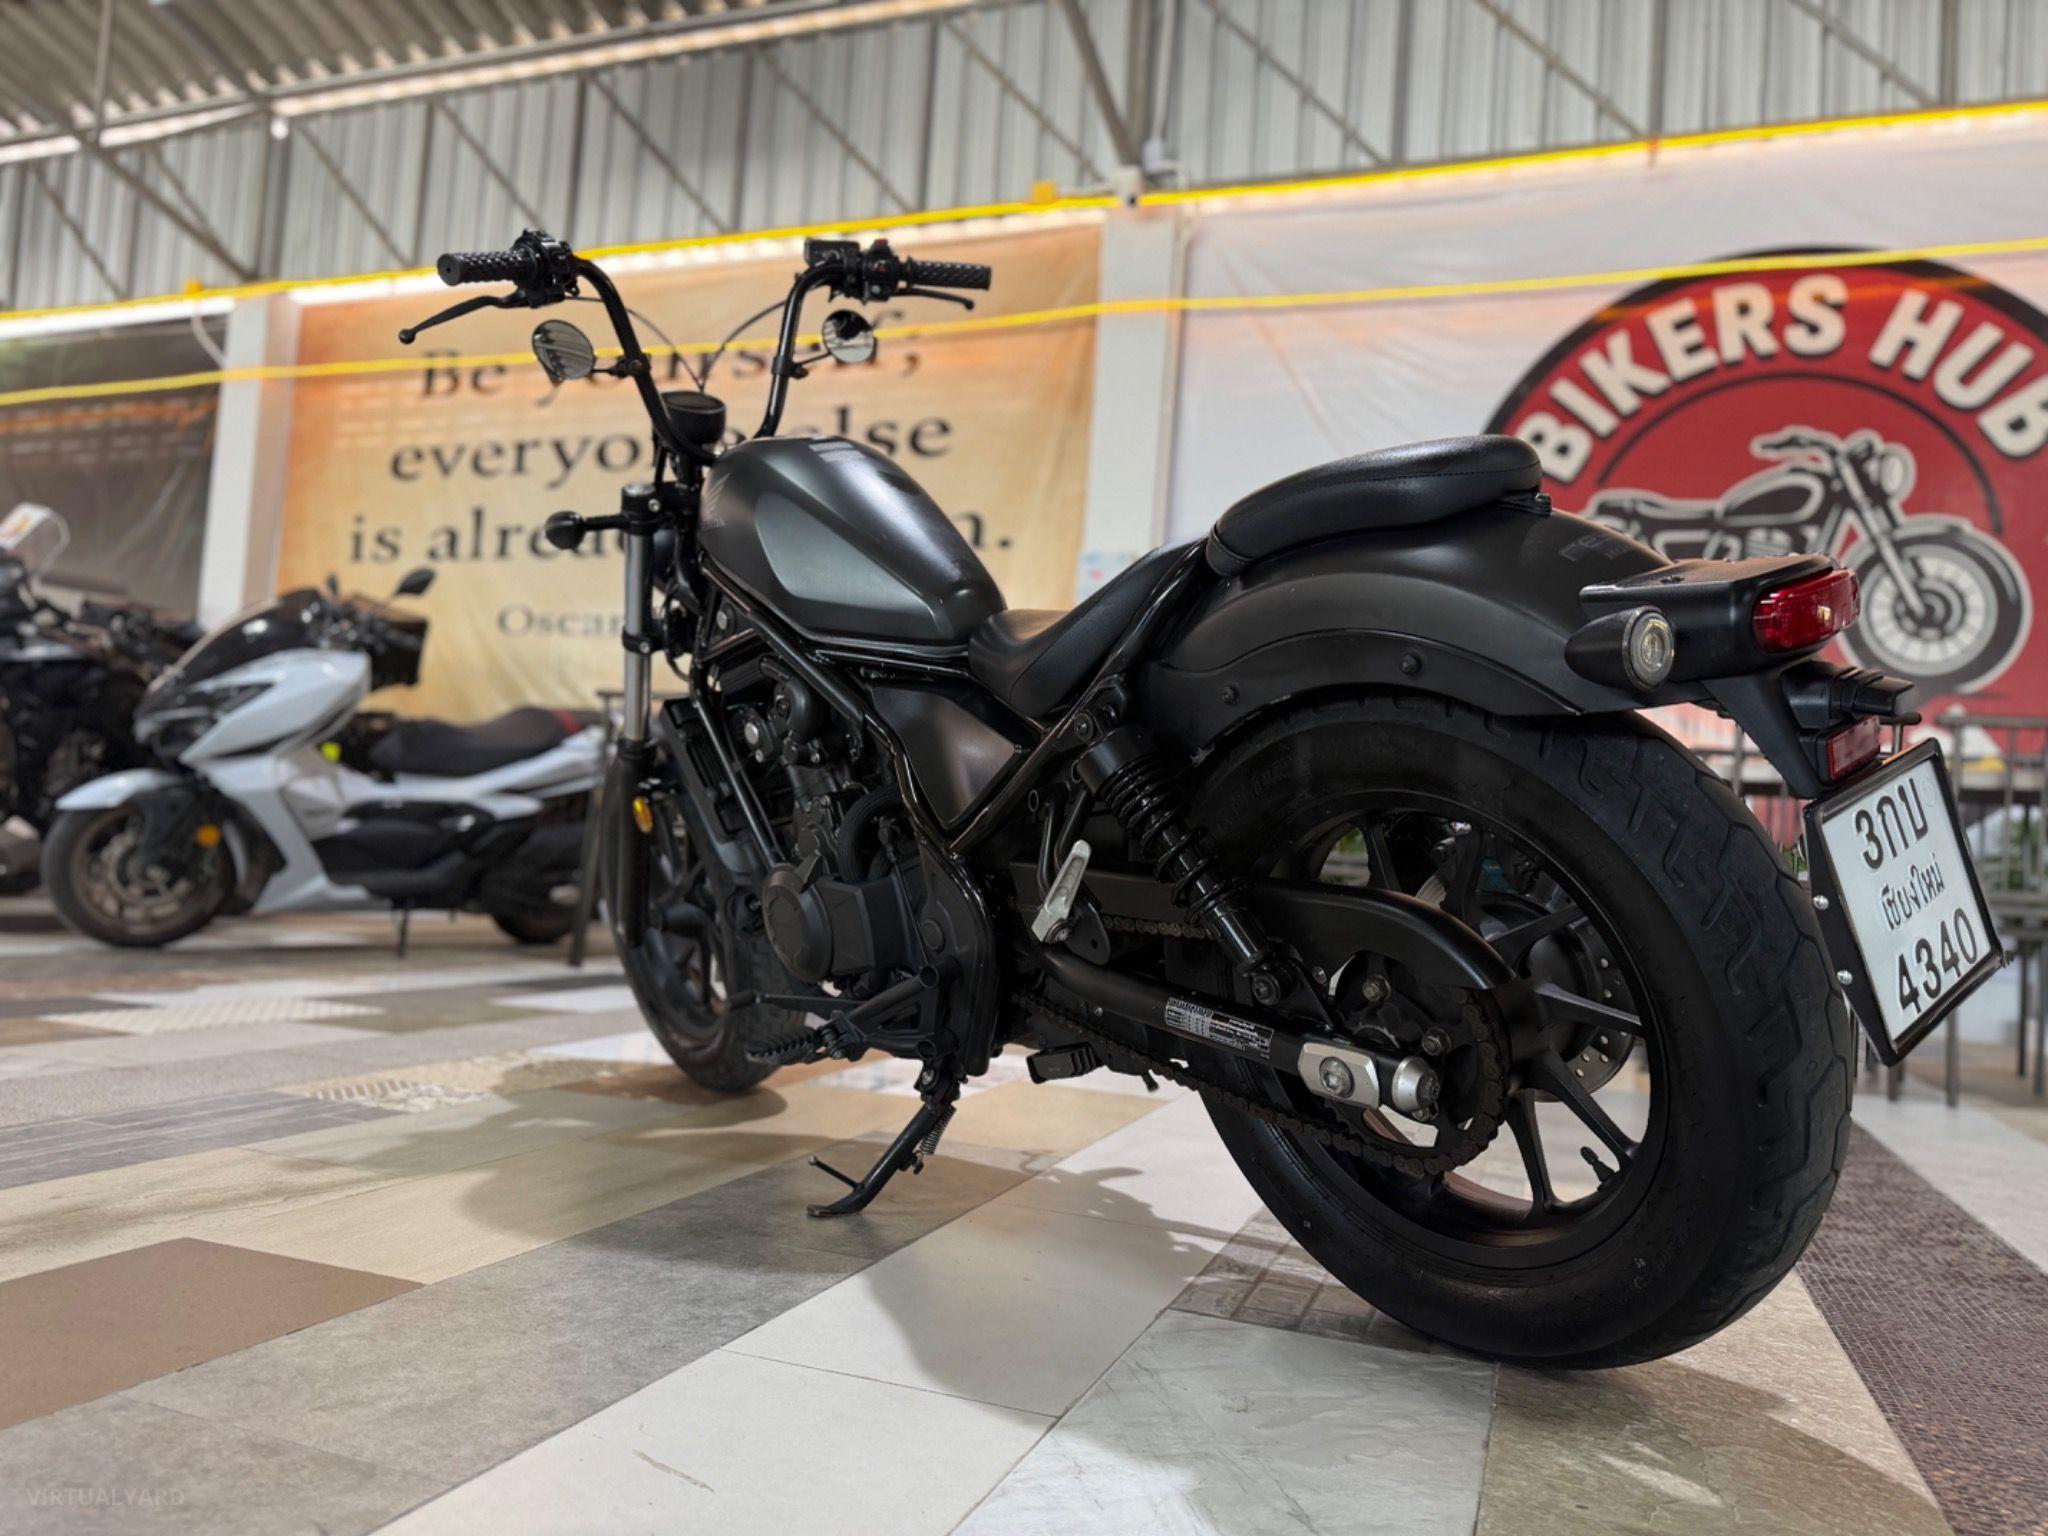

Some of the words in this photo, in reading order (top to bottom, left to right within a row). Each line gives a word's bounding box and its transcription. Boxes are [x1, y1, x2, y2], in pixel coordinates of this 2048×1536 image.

[422, 350, 508, 396] Be
[1515, 273, 1850, 485] BIKERS
[1868, 289, 2048, 459] HUB
[390, 430, 746, 490] everyo
[790, 403, 954, 459] lse
[350, 513, 402, 563] is
[1899, 908, 1977, 1014] 4340
